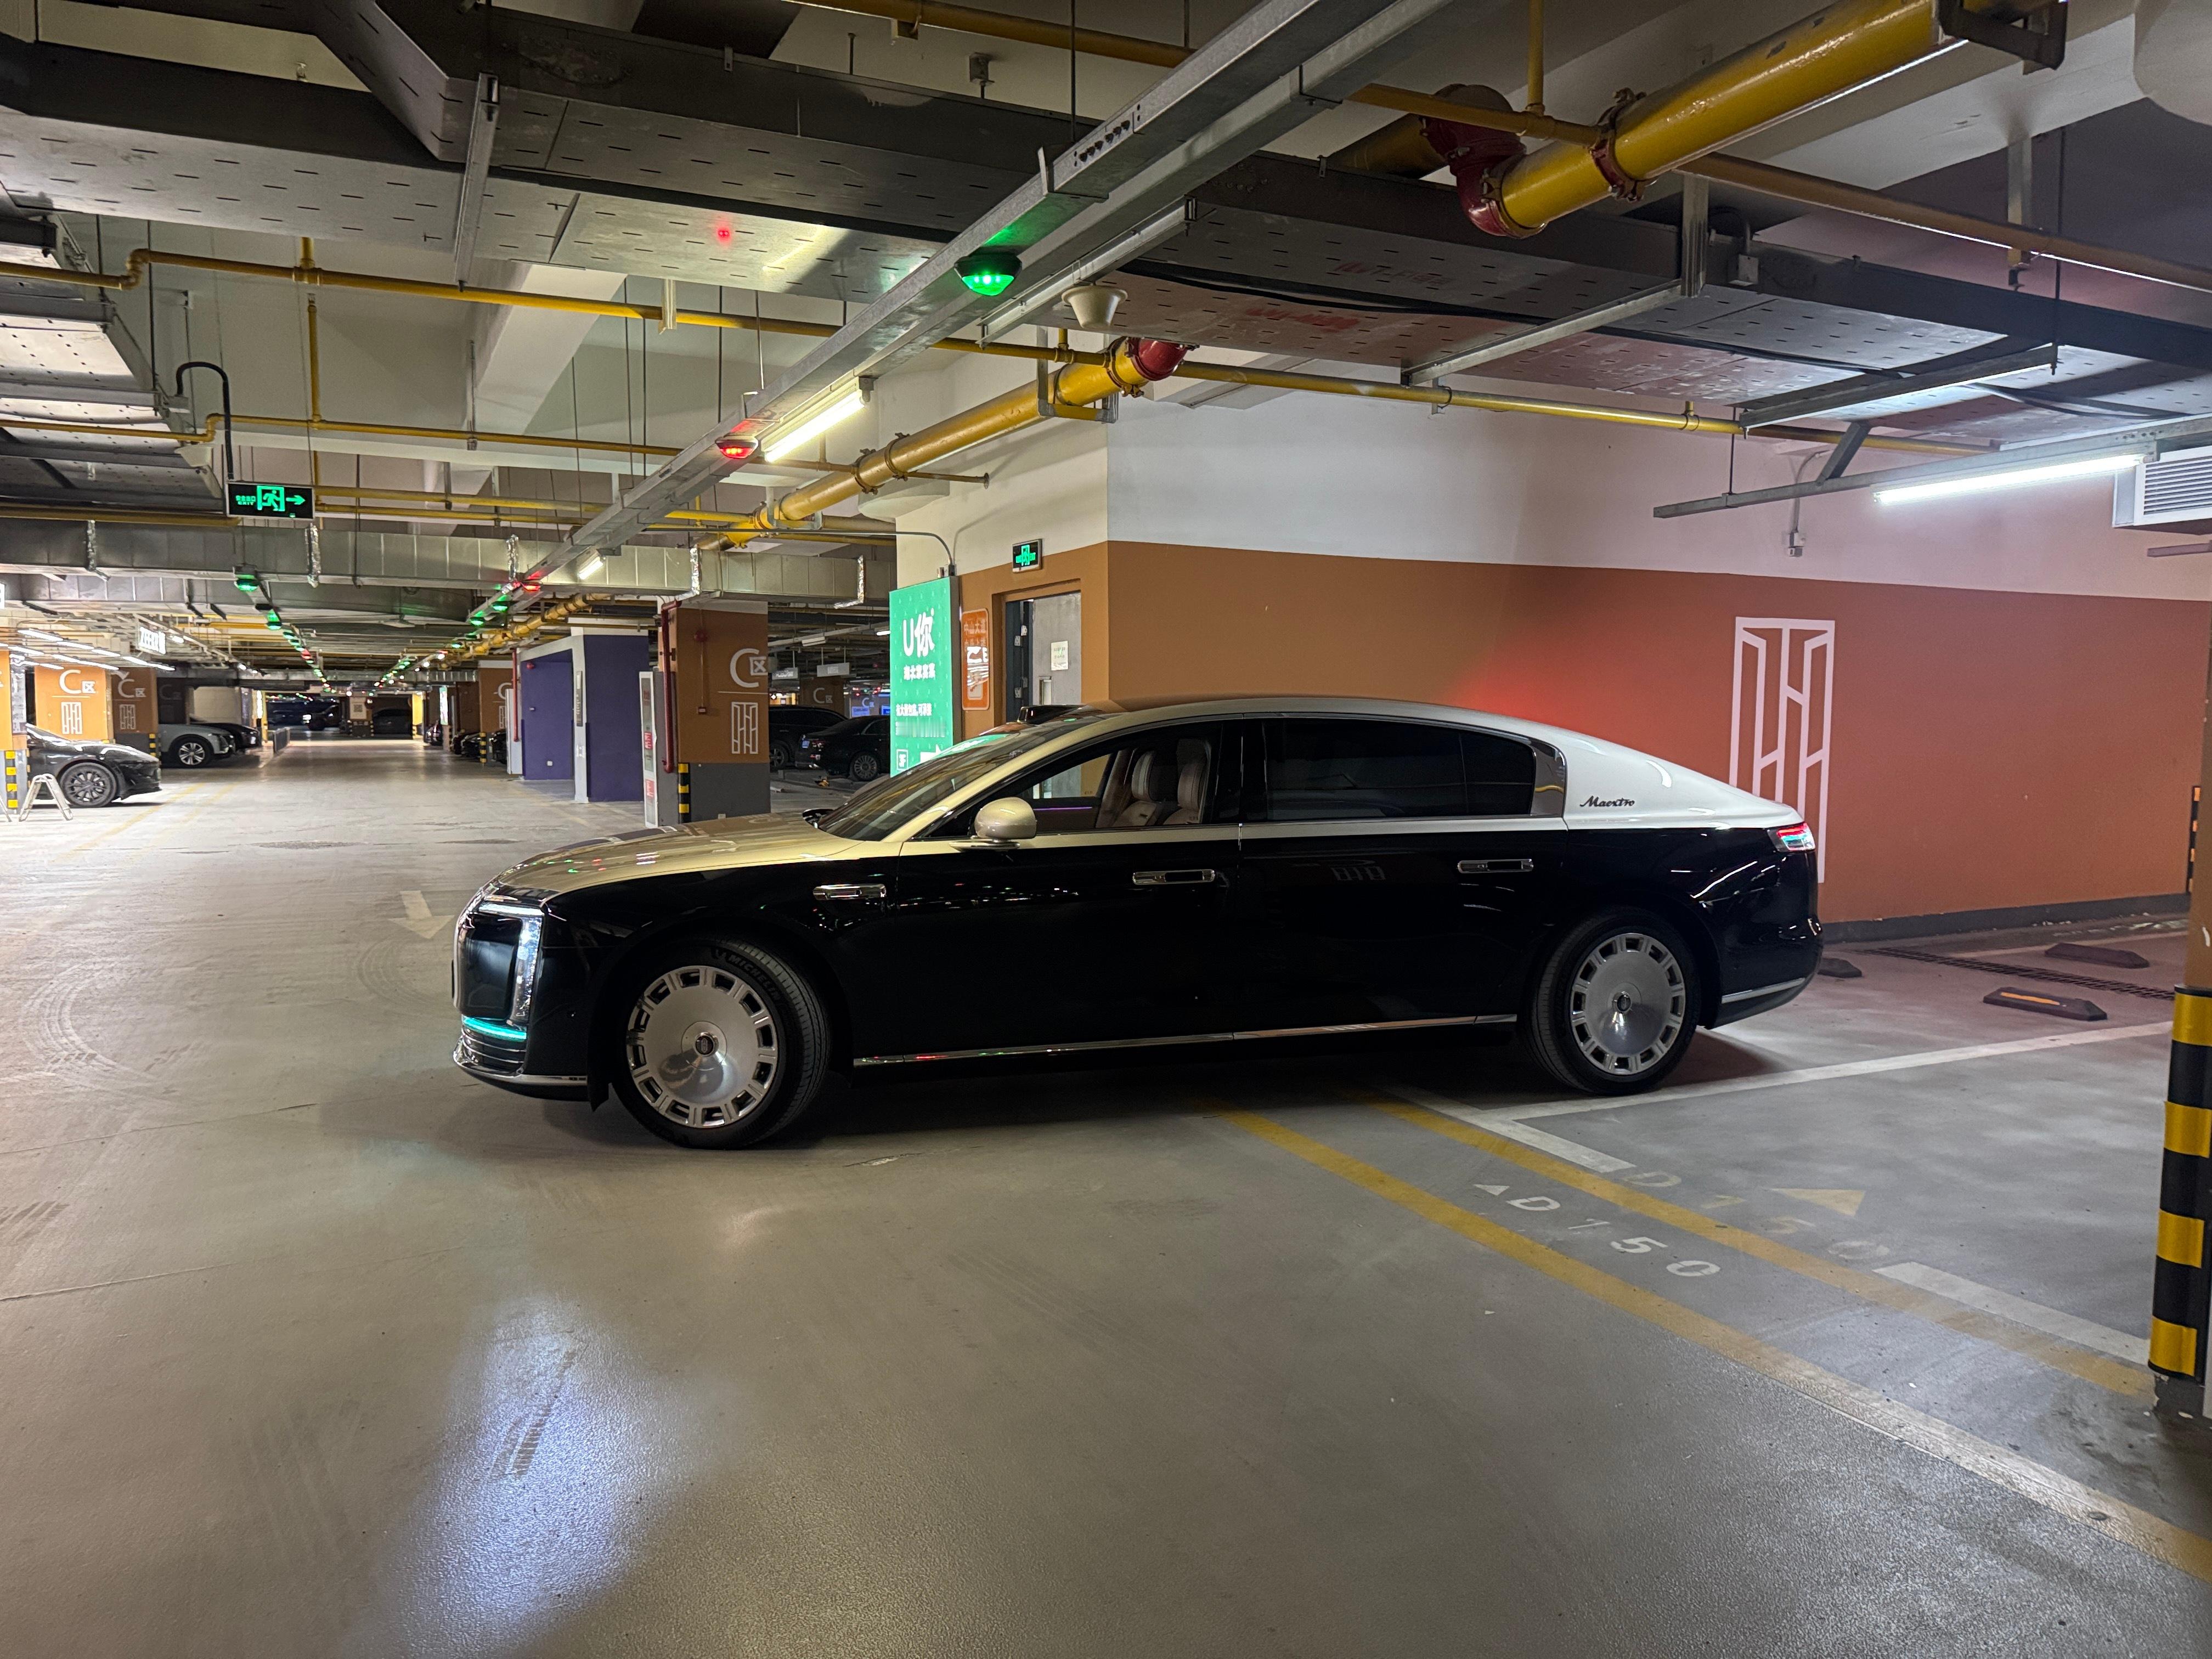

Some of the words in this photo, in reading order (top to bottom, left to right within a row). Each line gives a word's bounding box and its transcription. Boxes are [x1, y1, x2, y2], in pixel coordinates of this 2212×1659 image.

[730, 648, 768, 688] C区
[59, 669, 97, 693] C区
[118, 679, 146, 698] C区
[1579, 795, 1635, 807] Maextro
[728, 953, 781, 1001] MICHELIN
